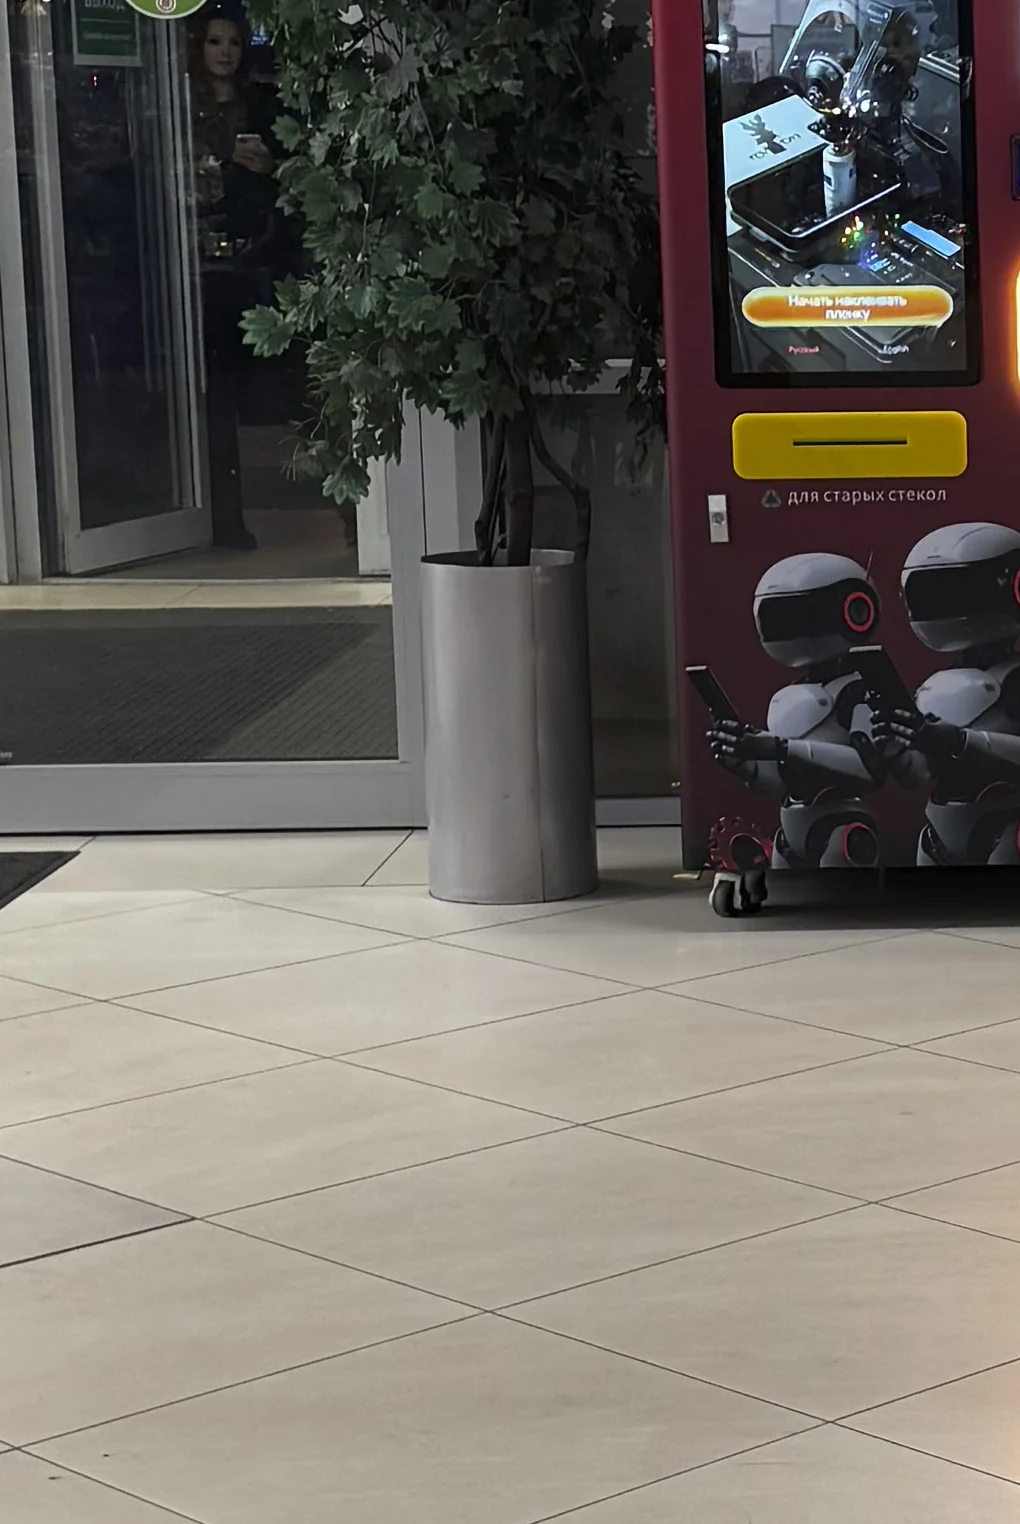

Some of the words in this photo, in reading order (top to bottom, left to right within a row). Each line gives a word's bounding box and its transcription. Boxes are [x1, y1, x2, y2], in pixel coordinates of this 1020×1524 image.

[788, 295, 834, 307] Начать
[787, 490, 820, 507] для
[823, 489, 885, 507] старых
[888, 488, 947, 503] стекол
